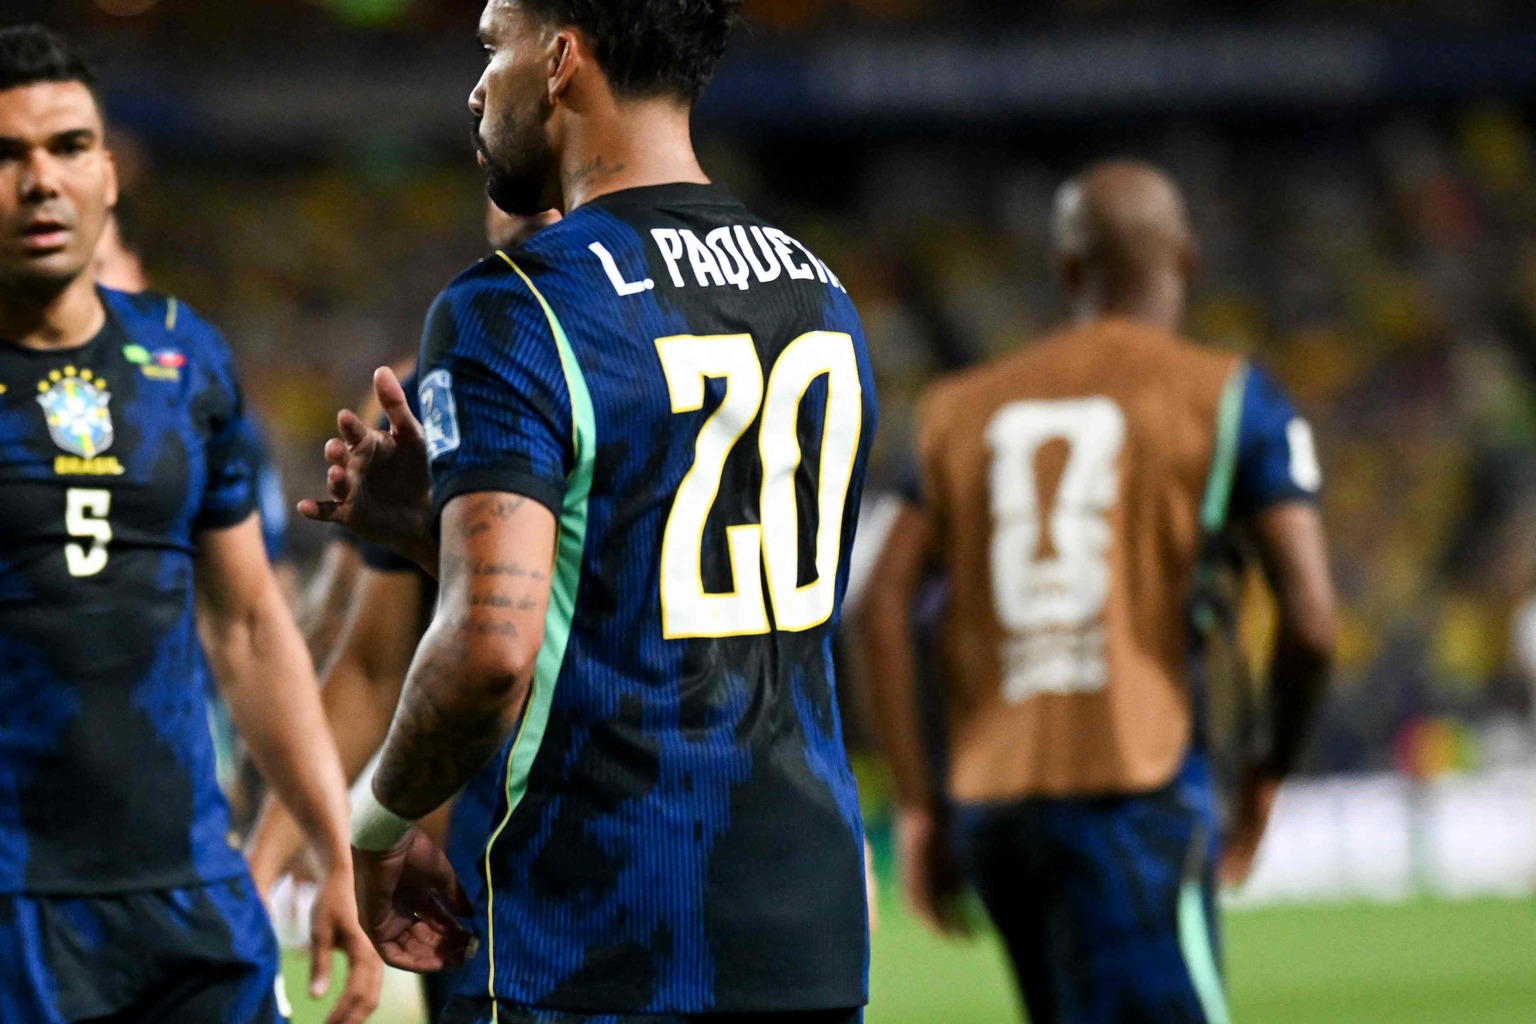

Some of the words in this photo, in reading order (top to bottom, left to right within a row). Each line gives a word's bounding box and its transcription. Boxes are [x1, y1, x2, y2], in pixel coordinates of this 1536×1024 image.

[588, 241, 655, 296] L.
[654, 330, 862, 640] 20
[65, 488, 112, 577] 5
